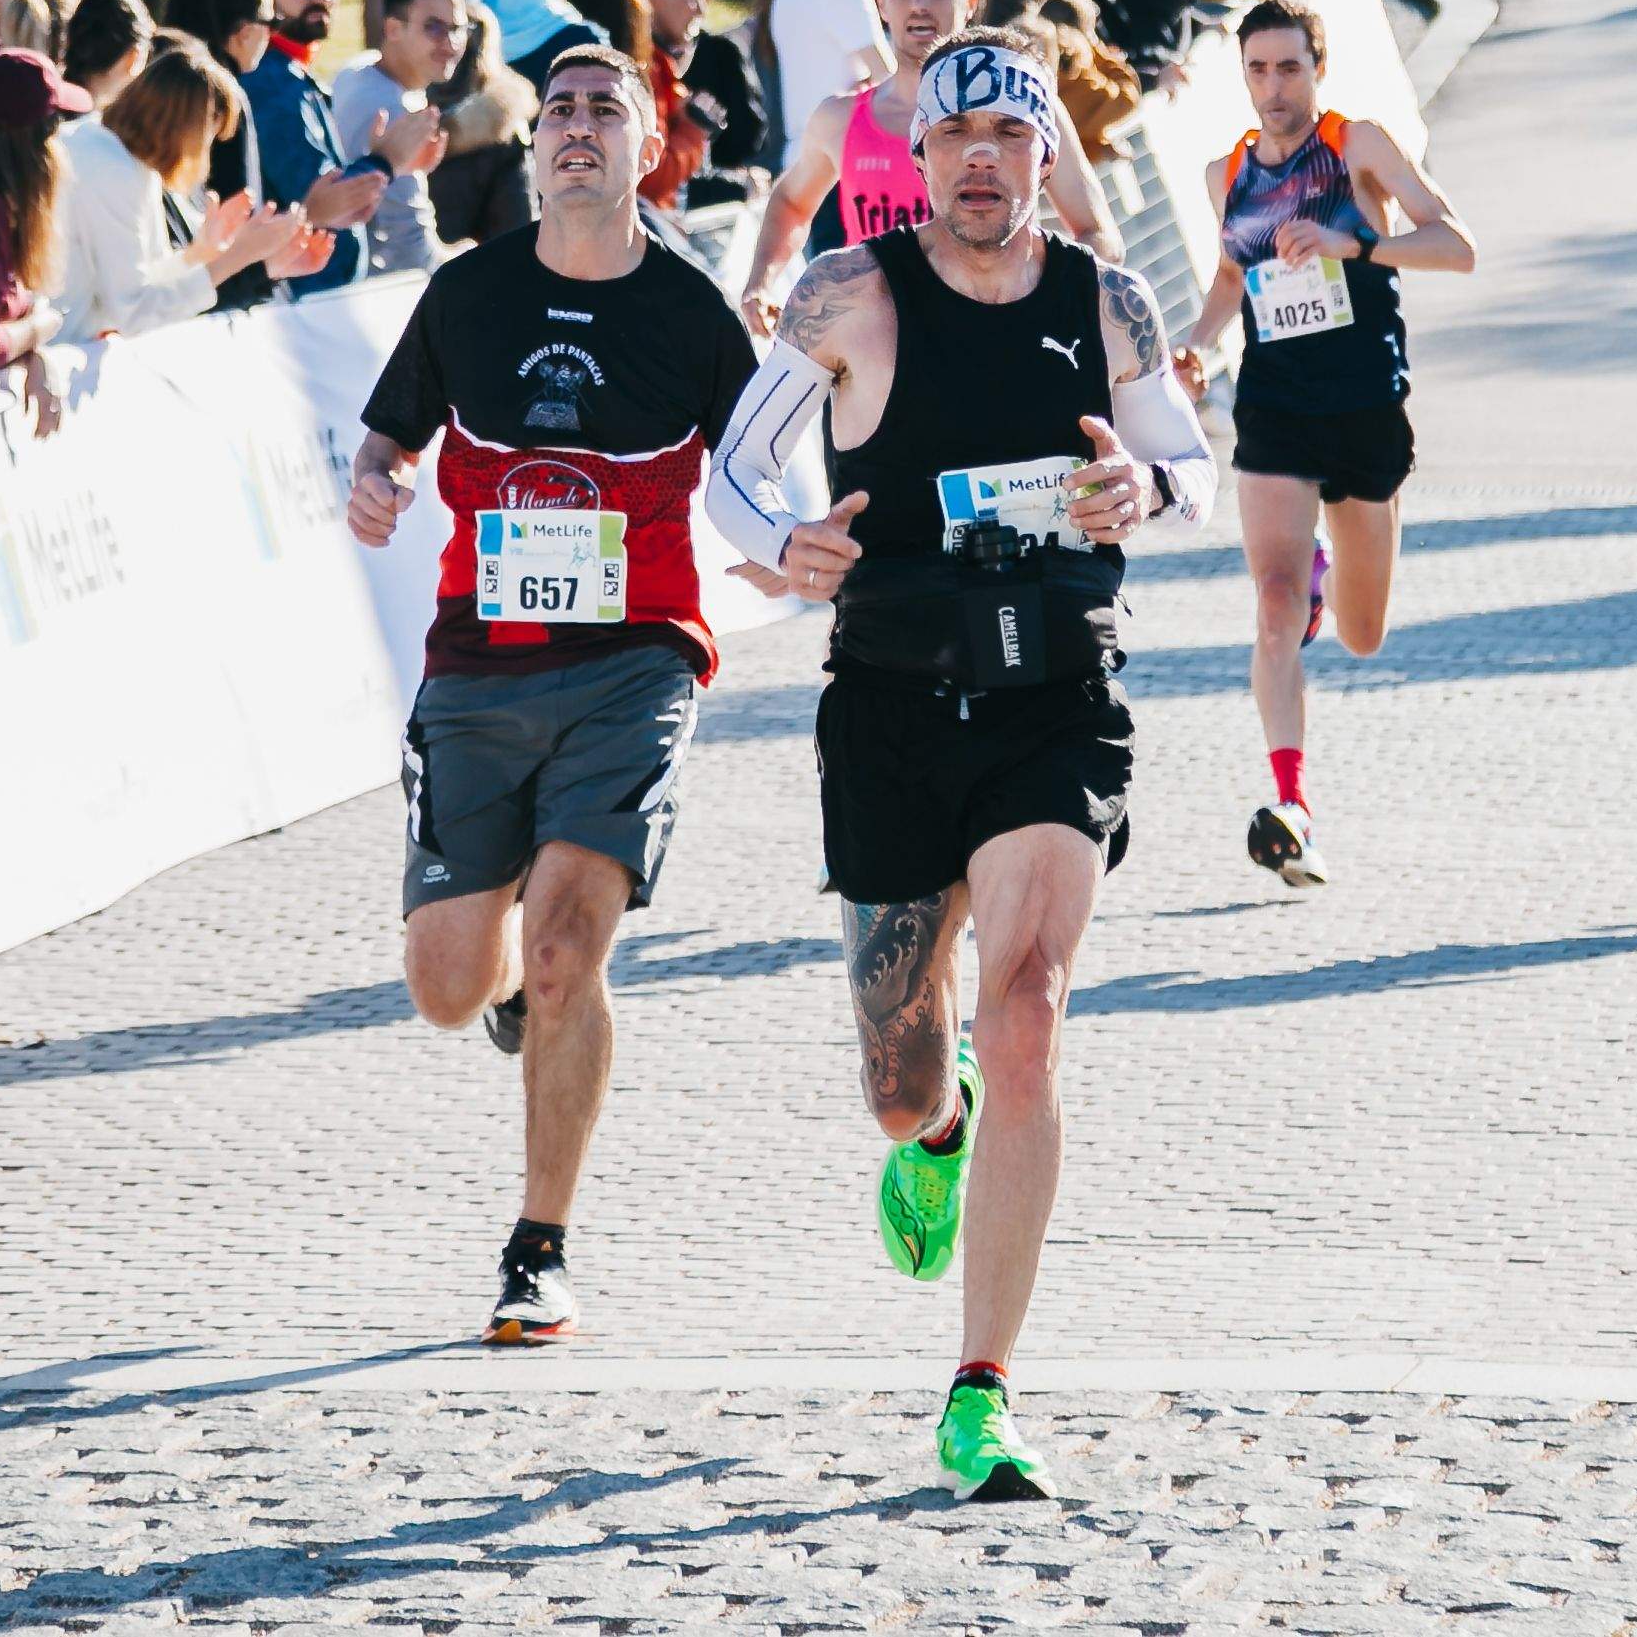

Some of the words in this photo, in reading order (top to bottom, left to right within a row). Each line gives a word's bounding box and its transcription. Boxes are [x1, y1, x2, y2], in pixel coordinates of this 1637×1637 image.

[1274, 298, 1326, 329] 4025
[517, 345, 551, 380] AMIGOS
[551, 343, 566, 355] DE
[567, 345, 605, 387] PANTACAS
[1007, 472, 1066, 493] MetLif
[533, 524, 593, 538] MetLife
[520, 575, 578, 611] 657
[998, 606, 1022, 668] CAMELBAK
